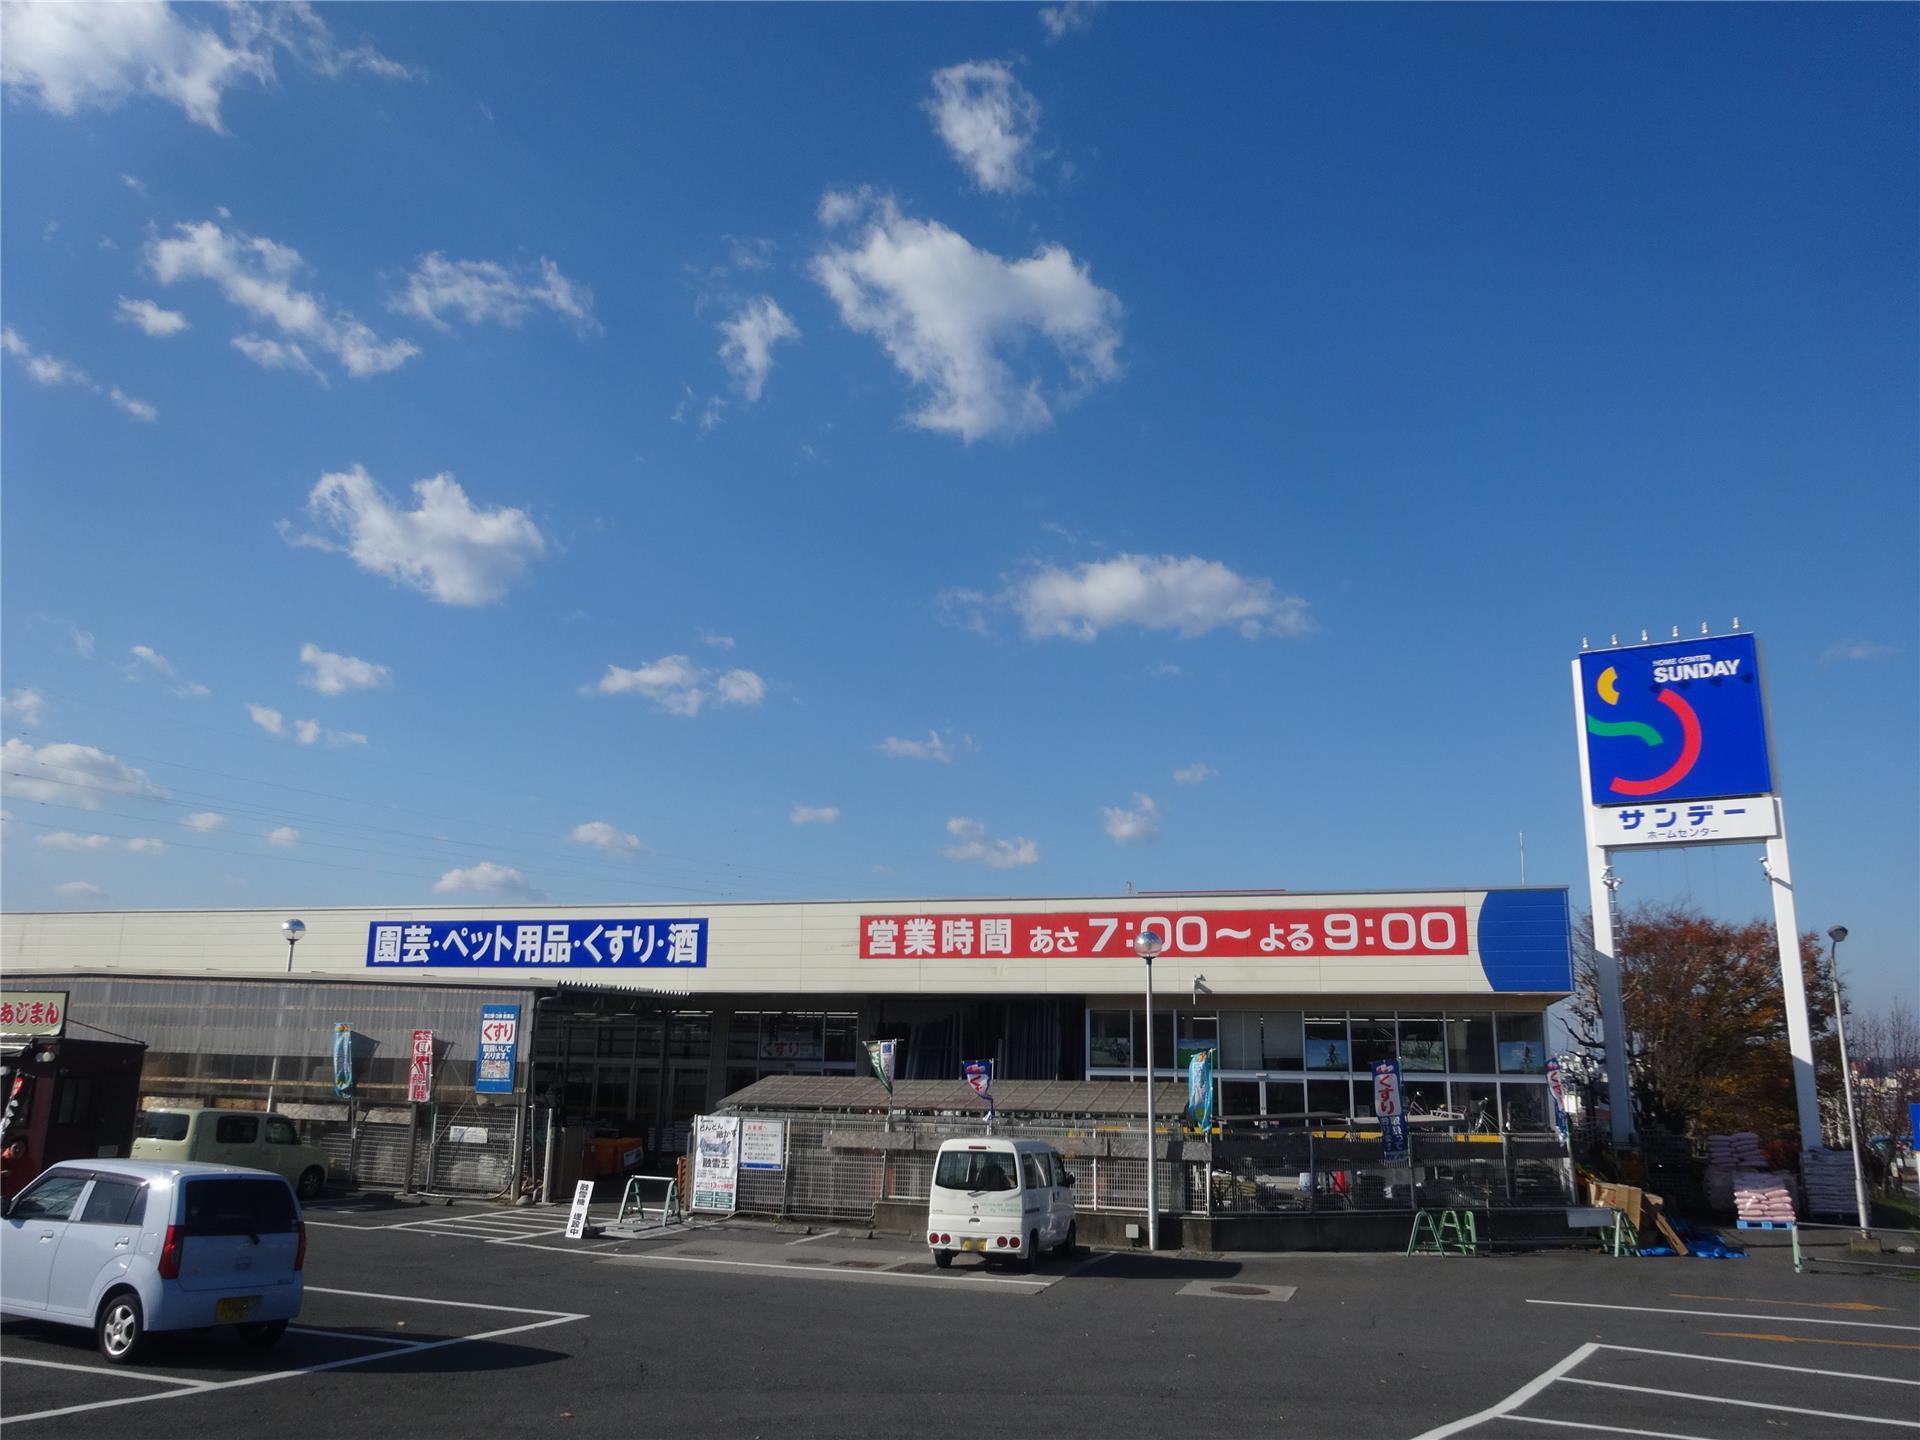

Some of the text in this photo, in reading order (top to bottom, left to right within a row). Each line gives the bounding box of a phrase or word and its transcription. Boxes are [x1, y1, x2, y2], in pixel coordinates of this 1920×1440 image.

[1653, 658, 1741, 683] SUNDAY
[1618, 805, 1746, 830] サンデー
[1647, 827, 1719, 839] ホームセンター
[867, 918, 1012, 956] 営業時間
[0, 1001, 60, 1025] あじまん
[483, 1023, 514, 1041] くすり
[1378, 1075, 1394, 1115] くすり
[699, 1123, 724, 1132] どんどん
[702, 1157, 730, 1169] 融雪王
